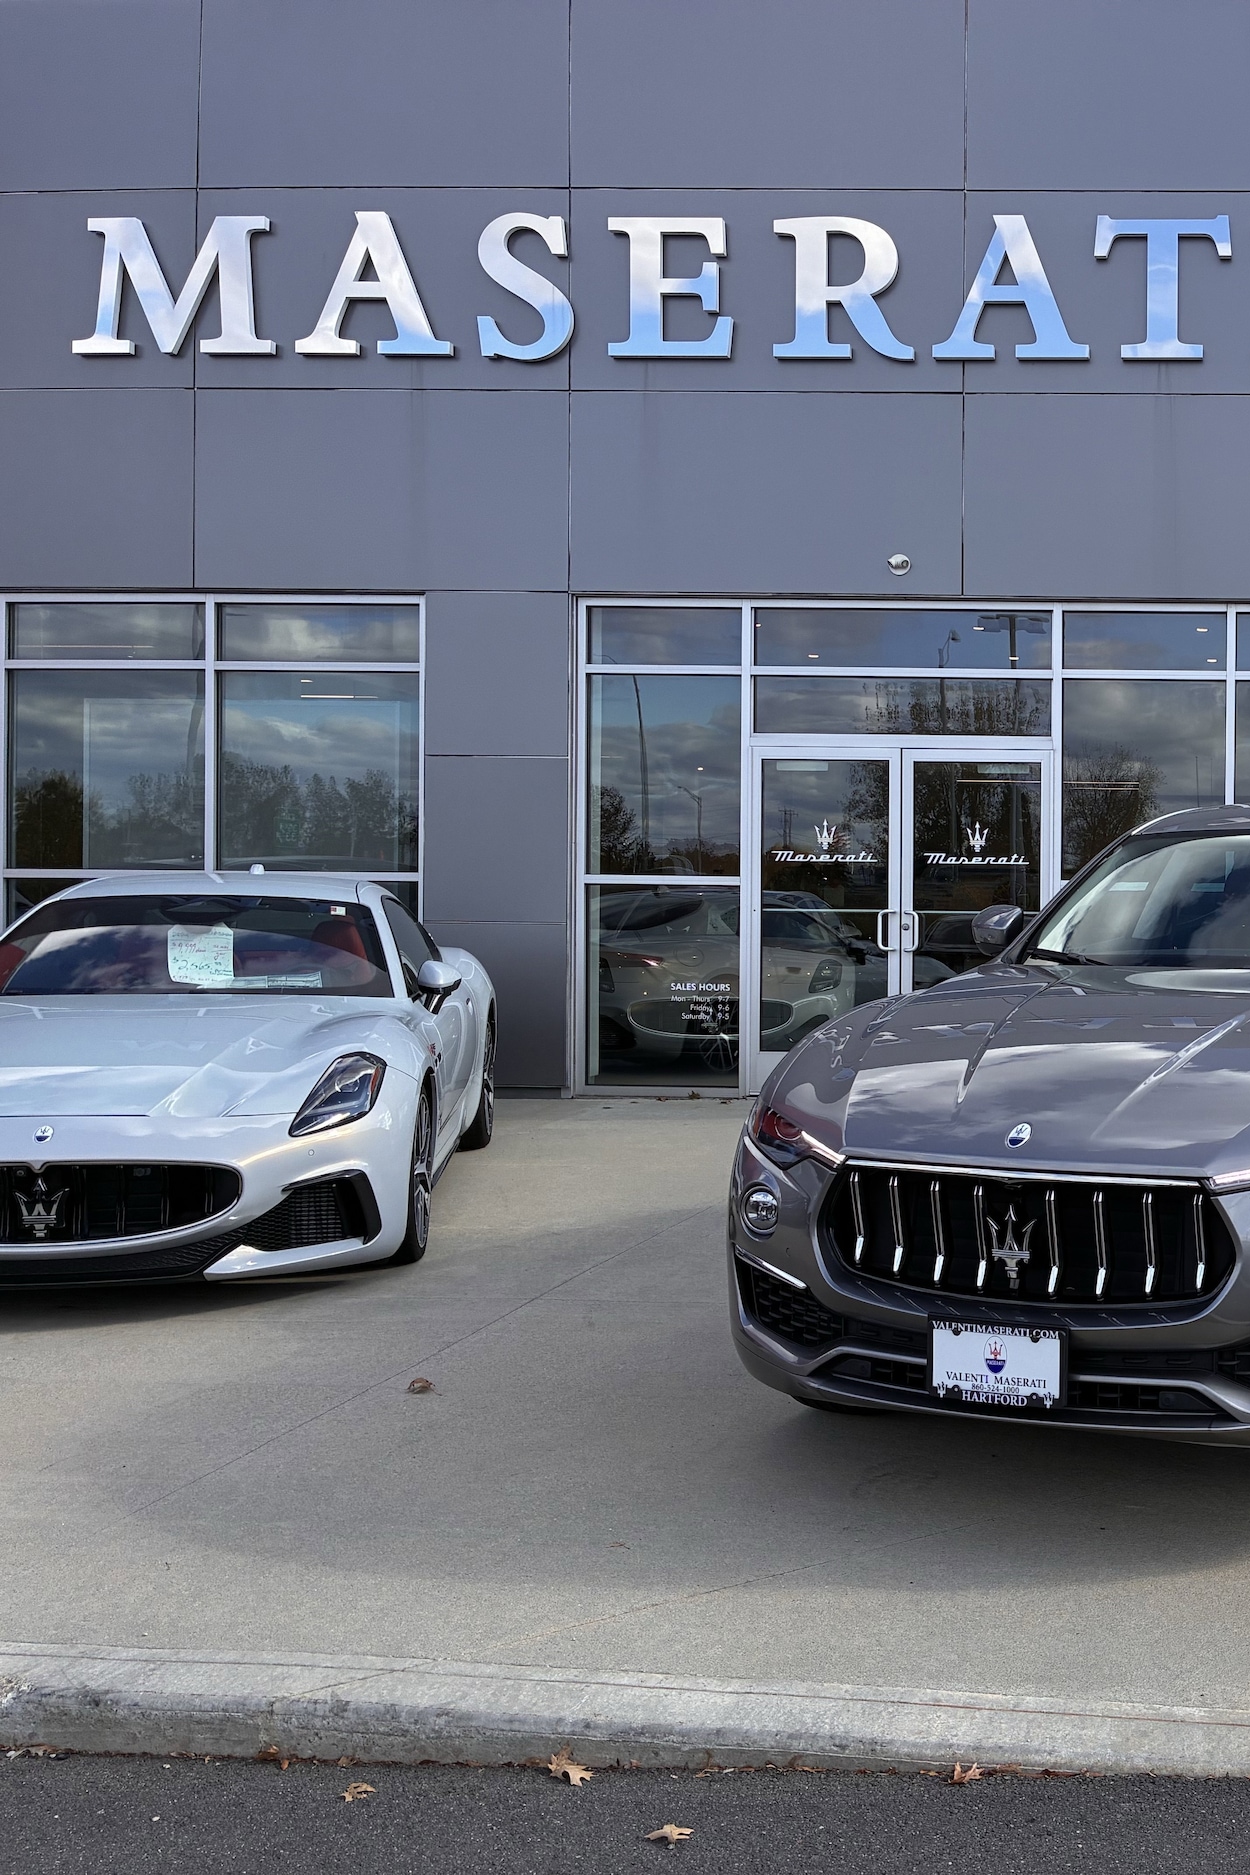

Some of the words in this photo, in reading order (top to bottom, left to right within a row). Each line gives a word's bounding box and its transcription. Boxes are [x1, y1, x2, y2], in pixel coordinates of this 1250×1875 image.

[771, 850, 878, 862] Maserati
[923, 852, 1030, 865] Maserati
[671, 982, 696, 991] SALES
[699, 983, 730, 991] HOURS
[690, 1004, 710, 1012] Friday
[717, 1012, 730, 1020] 9-5
[932, 1320, 1059, 1340] VALENTIMASERATI.COM
[945, 1371, 989, 1384] VALENTI
[994, 1375, 1047, 1389] MASERATI
[971, 1383, 1020, 1394] 860-524-1000
[961, 1390, 1028, 1406] HARTFORD
